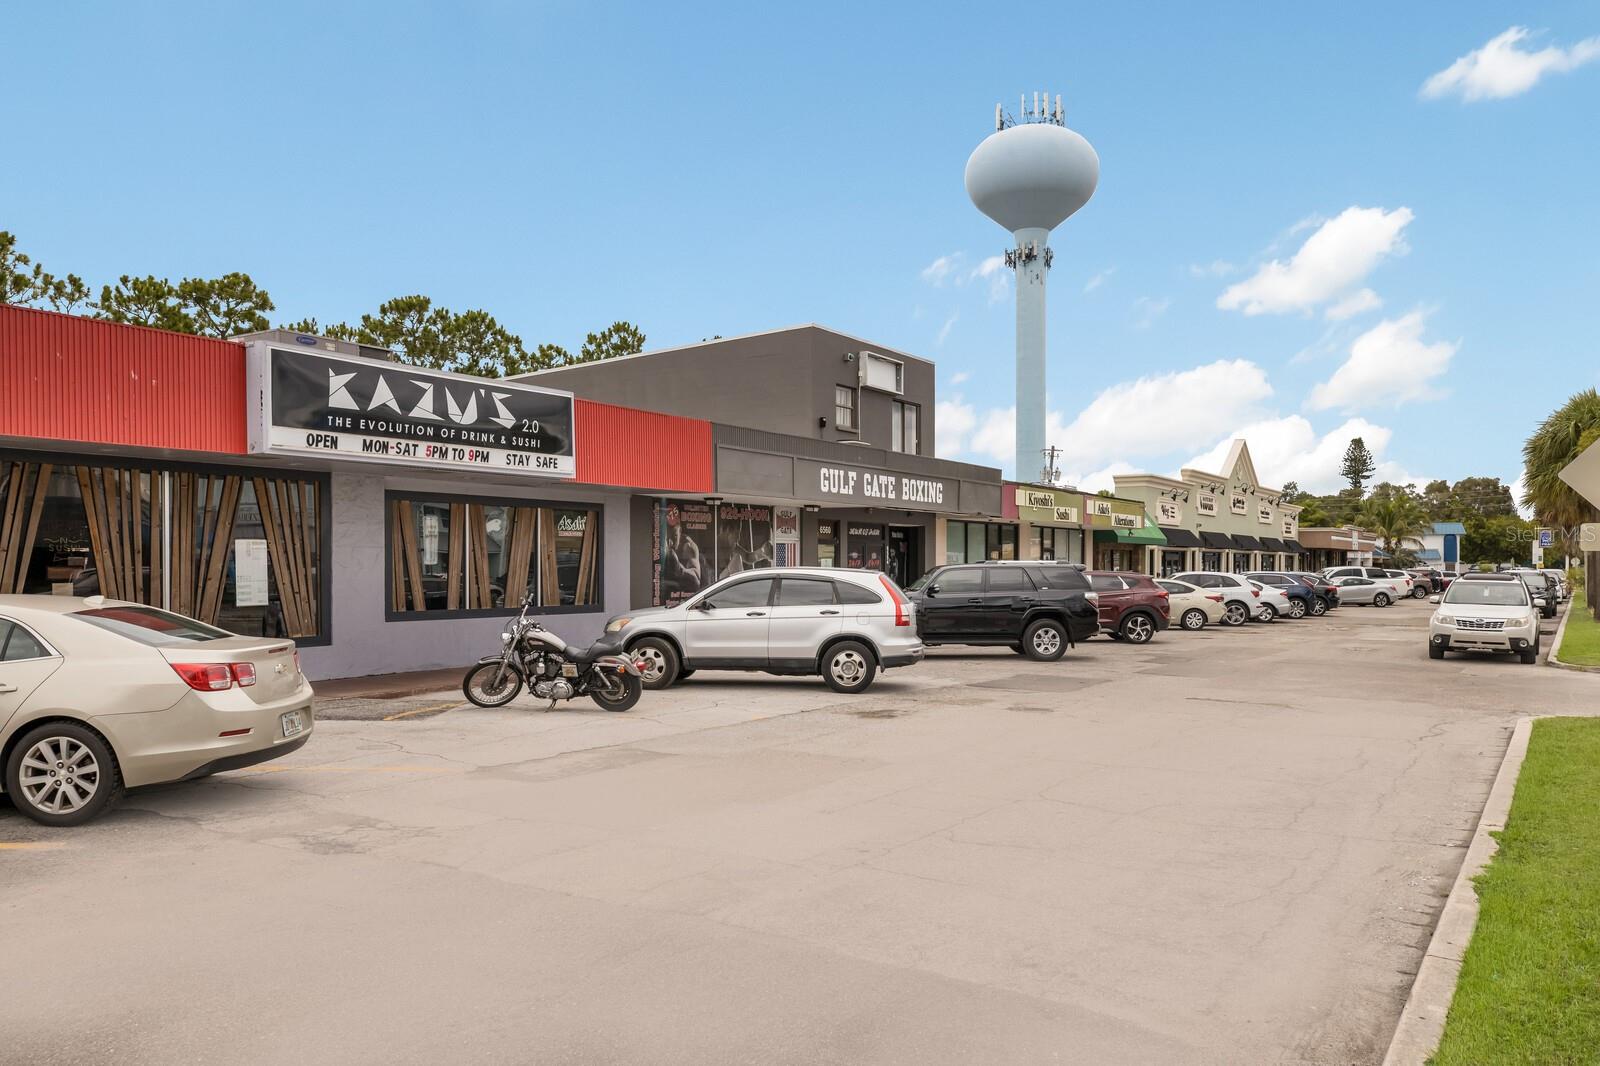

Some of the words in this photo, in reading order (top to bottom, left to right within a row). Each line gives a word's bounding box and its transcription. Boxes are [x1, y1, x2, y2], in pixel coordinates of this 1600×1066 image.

[328, 367, 517, 429] KAZU'S
[327, 415, 352, 428] THE
[360, 419, 434, 436] EVOLUTION
[440, 428, 456, 439] OF
[461, 431, 495, 443] DRINK
[500, 435, 507, 444] &
[511, 436, 541, 449] SUSHI
[521, 418, 540, 434] 2.0
[306, 432, 339, 450] OPEN
[362, 438, 419, 457] MON-SAT
[425, 445, 449, 460] 5PM
[452, 447, 466, 461] TO
[468, 449, 490, 463] 9PM
[506, 453, 531, 466] STAY
[536, 456, 558, 469] SAFE
[820, 467, 857, 495] GULF
[863, 473, 896, 499] GATE
[902, 478, 943, 504] BOXING
[819, 526, 832, 535] 6560
[1055, 507, 1070, 521] Sushi
